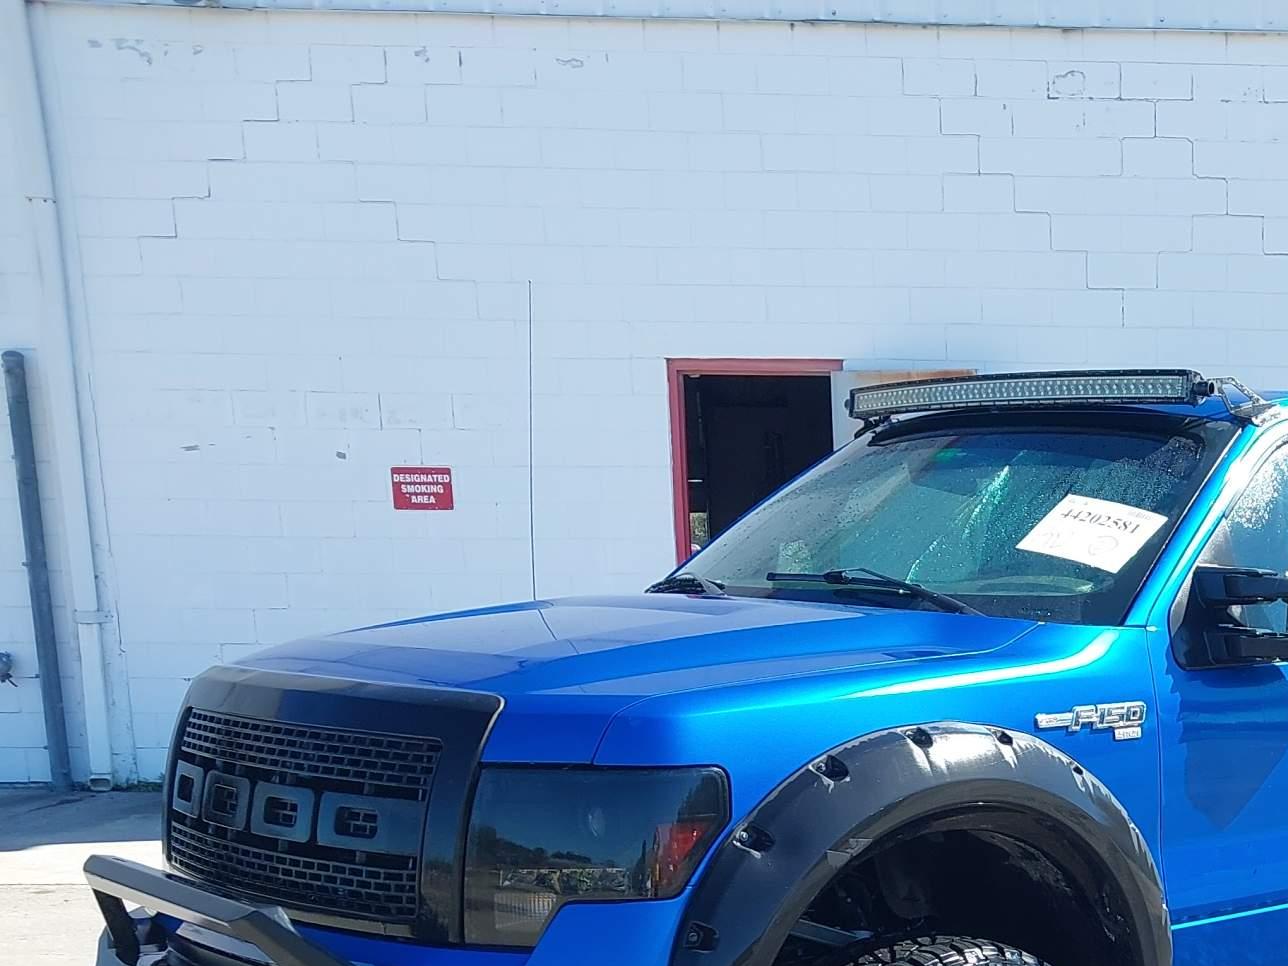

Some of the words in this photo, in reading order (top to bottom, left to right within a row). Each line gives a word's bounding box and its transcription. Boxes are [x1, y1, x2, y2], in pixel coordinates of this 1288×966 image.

[393, 474, 450, 482] DESIGNATED
[401, 484, 444, 493] SMOKING
[411, 495, 436, 503] AREA
[1061, 508, 1141, 534] 44202581
